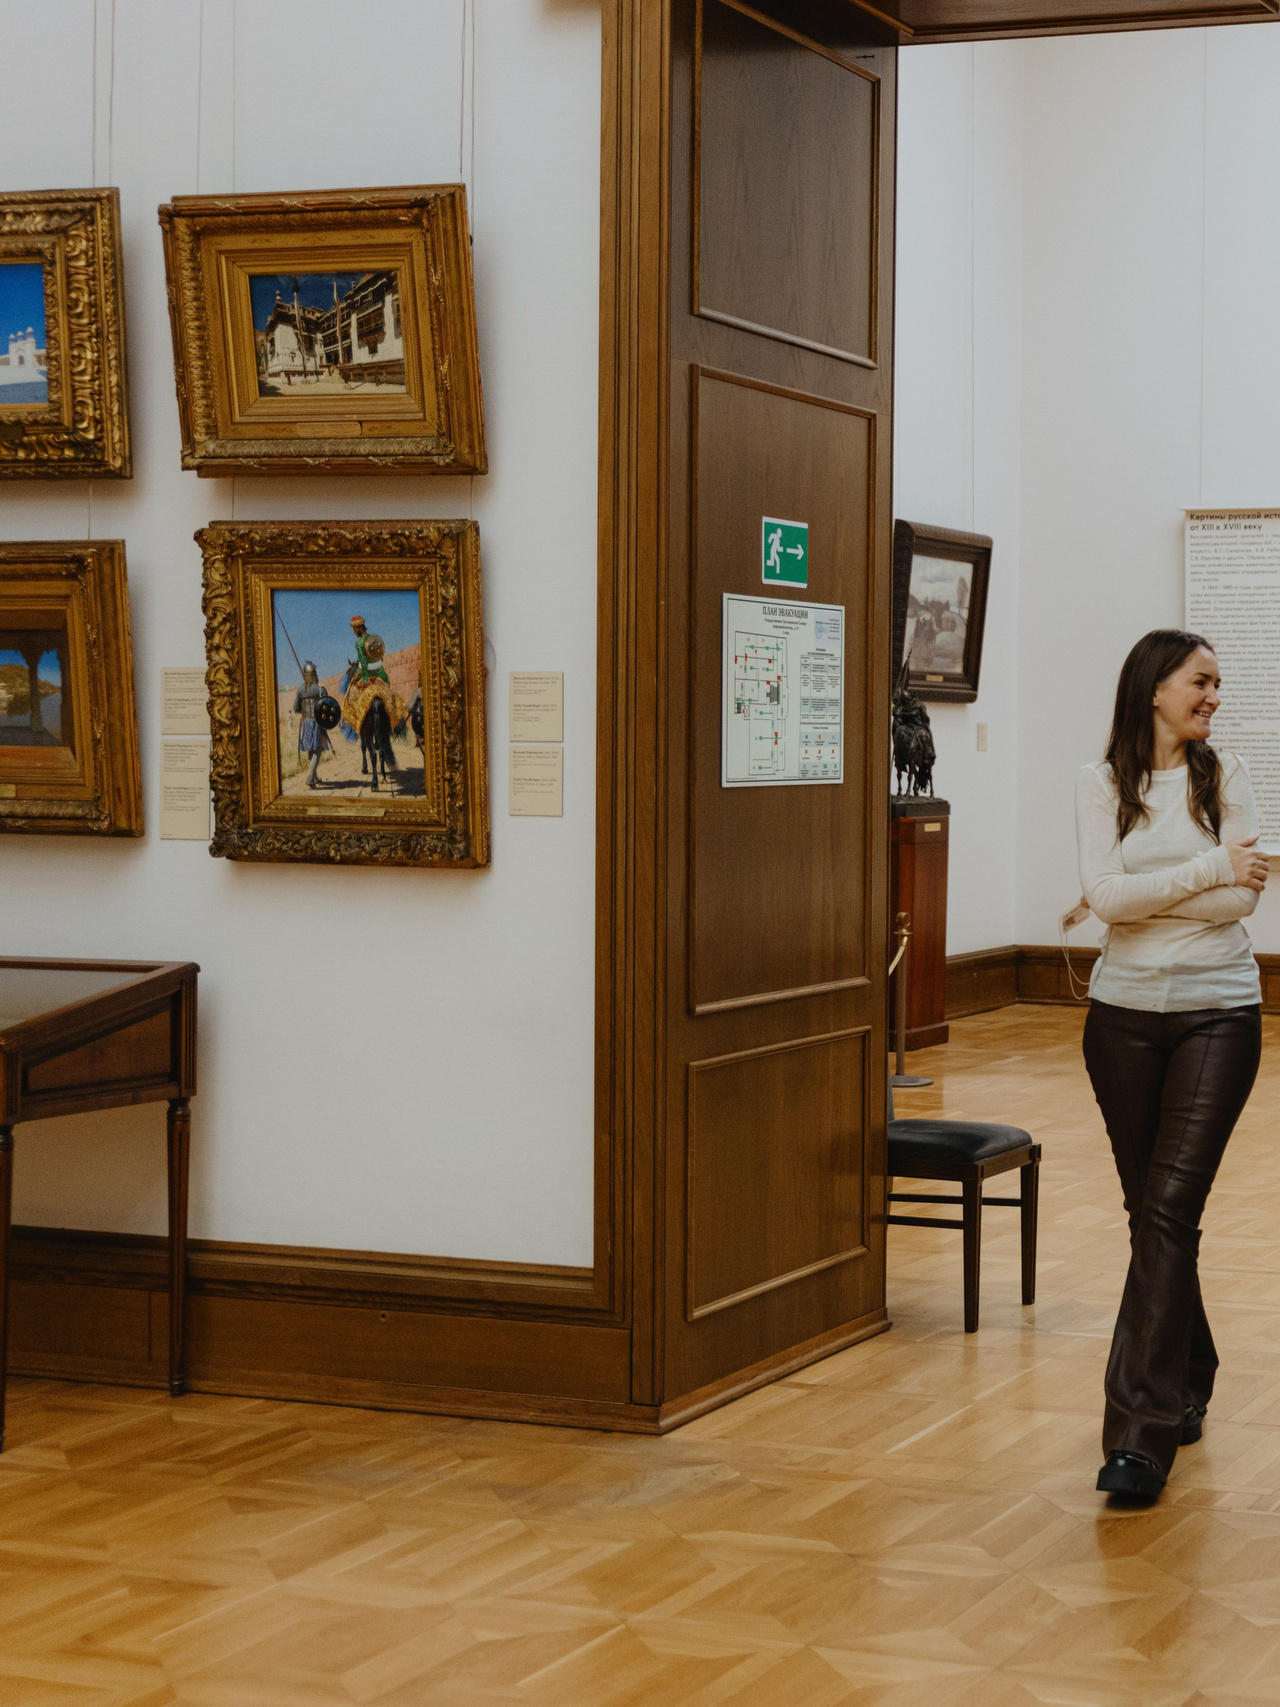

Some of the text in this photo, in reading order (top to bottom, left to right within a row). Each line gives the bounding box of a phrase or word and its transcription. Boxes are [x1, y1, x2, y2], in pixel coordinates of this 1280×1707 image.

[1190, 513, 1226, 521] Картины
[1228, 512, 1262, 521] русской
[762, 606, 809, 619] ПЛАН ЭВАКУАЦИИ
